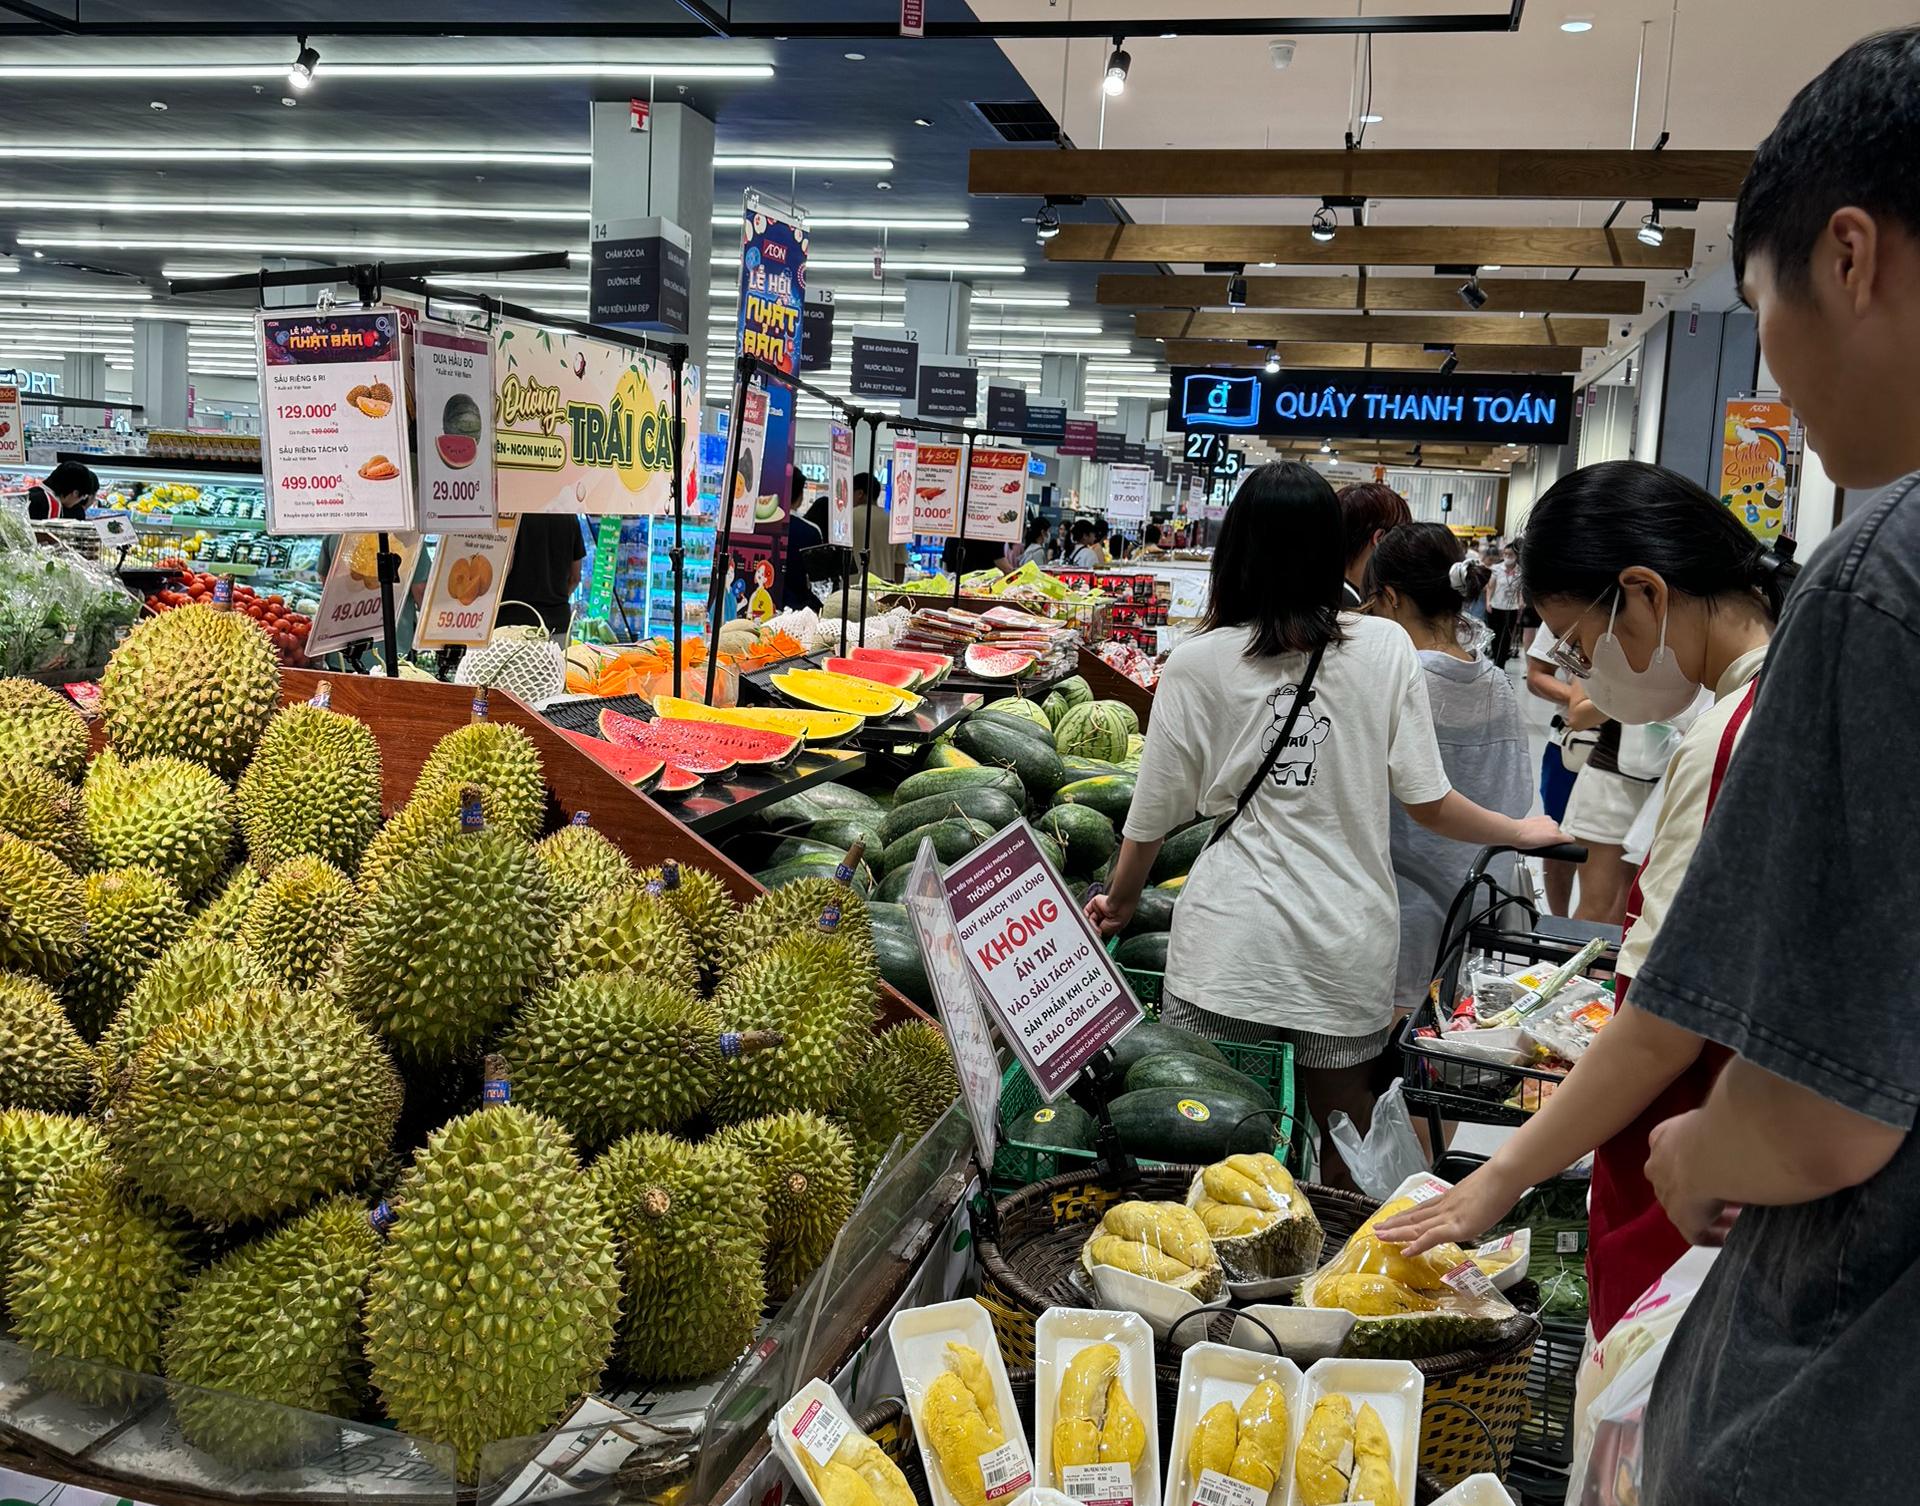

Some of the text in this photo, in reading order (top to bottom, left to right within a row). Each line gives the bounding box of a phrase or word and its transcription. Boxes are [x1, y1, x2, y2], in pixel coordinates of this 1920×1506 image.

[595, 224, 607, 239] 14
[624, 248, 635, 258] SÓC
[636, 249, 645, 257] DA
[819, 290, 833, 303] 13
[905, 331, 918, 342] 12
[968, 358, 978, 368] 11
[1363, 393, 1464, 421] THANH
[1473, 393, 1557, 424] TOÁN
[567, 395, 633, 463] TRÁI
[548, 445, 562, 458] LÚC
[1187, 433, 1216, 458] 27
[433, 479, 481, 502] 29.000đ
[914, 506, 952, 519] 0.000đ
[437, 611, 484, 629] 59.000đ
[966, 866, 1012, 904] THÔNG BÁO
[973, 869, 986, 880] AEON
[960, 872, 1045, 941] QUÝ KHÁCH VUI LÒNG
[976, 898, 1059, 972] KHÔNG
[1013, 938, 1058, 982] ẤN TAY
[1007, 942, 1090, 1017] VÀO SẦU TÁCH VỎ
[1023, 1017, 1044, 1037] SẢN
[1041, 996, 1068, 1023] PHẨM
[1065, 982, 1083, 1002] KHI
[1032, 979, 1113, 1056] ĐÃ BAO GỒM CẢ VỎ
[1049, 1071, 1059, 1081] XIN
[1057, 1058, 1072, 1073] CHÂN
[1070, 1046, 1086, 1062] THÀNH
[1084, 1037, 1096, 1049] CẢM
[1100, 1023, 1112, 1035] QUÝ
[1109, 1011, 1126, 1027] KHÁCH
